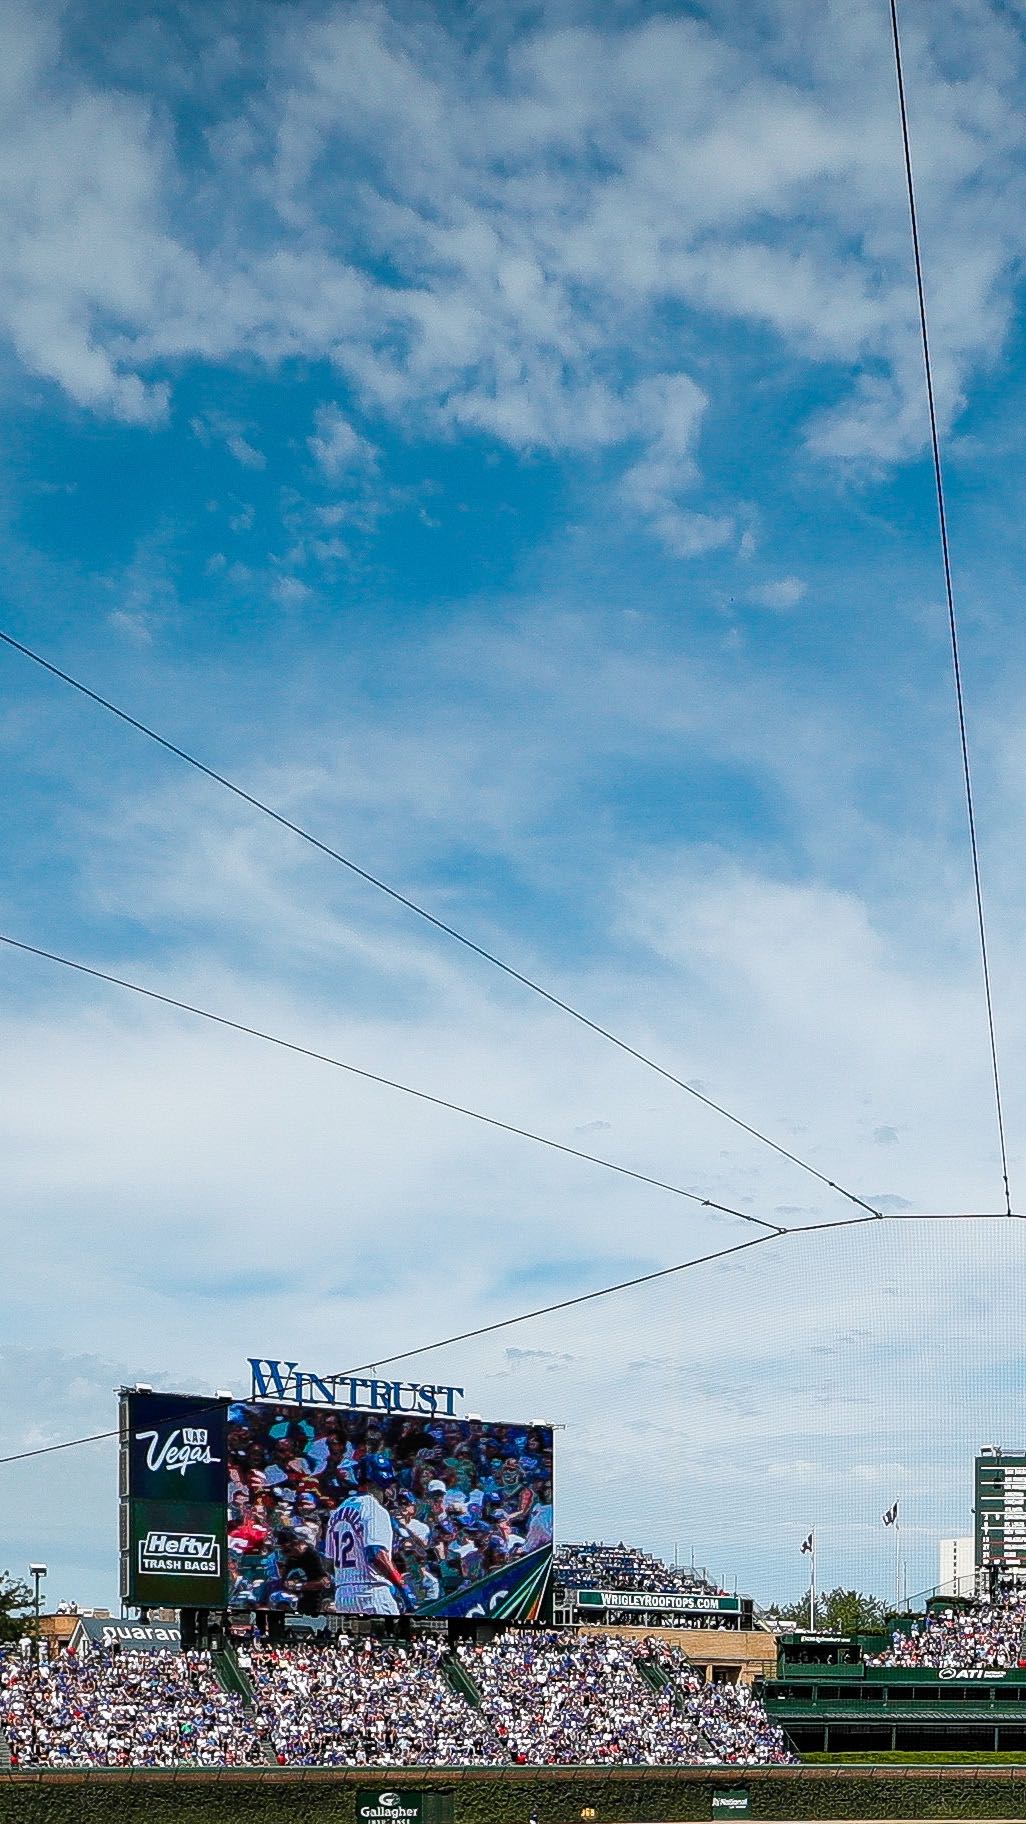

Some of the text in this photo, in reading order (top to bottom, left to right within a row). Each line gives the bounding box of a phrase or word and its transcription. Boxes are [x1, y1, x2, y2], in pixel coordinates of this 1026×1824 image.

[184, 1430, 207, 1444] LAS
[135, 1429, 221, 1476] Vegas
[148, 1534, 211, 1557] Hefty
[333, 1531, 356, 1567] 12
[143, 1558, 216, 1571] TRASH BAGS
[956, 1669, 983, 1678] ATI
[360, 1806, 418, 1818] Gallagher
